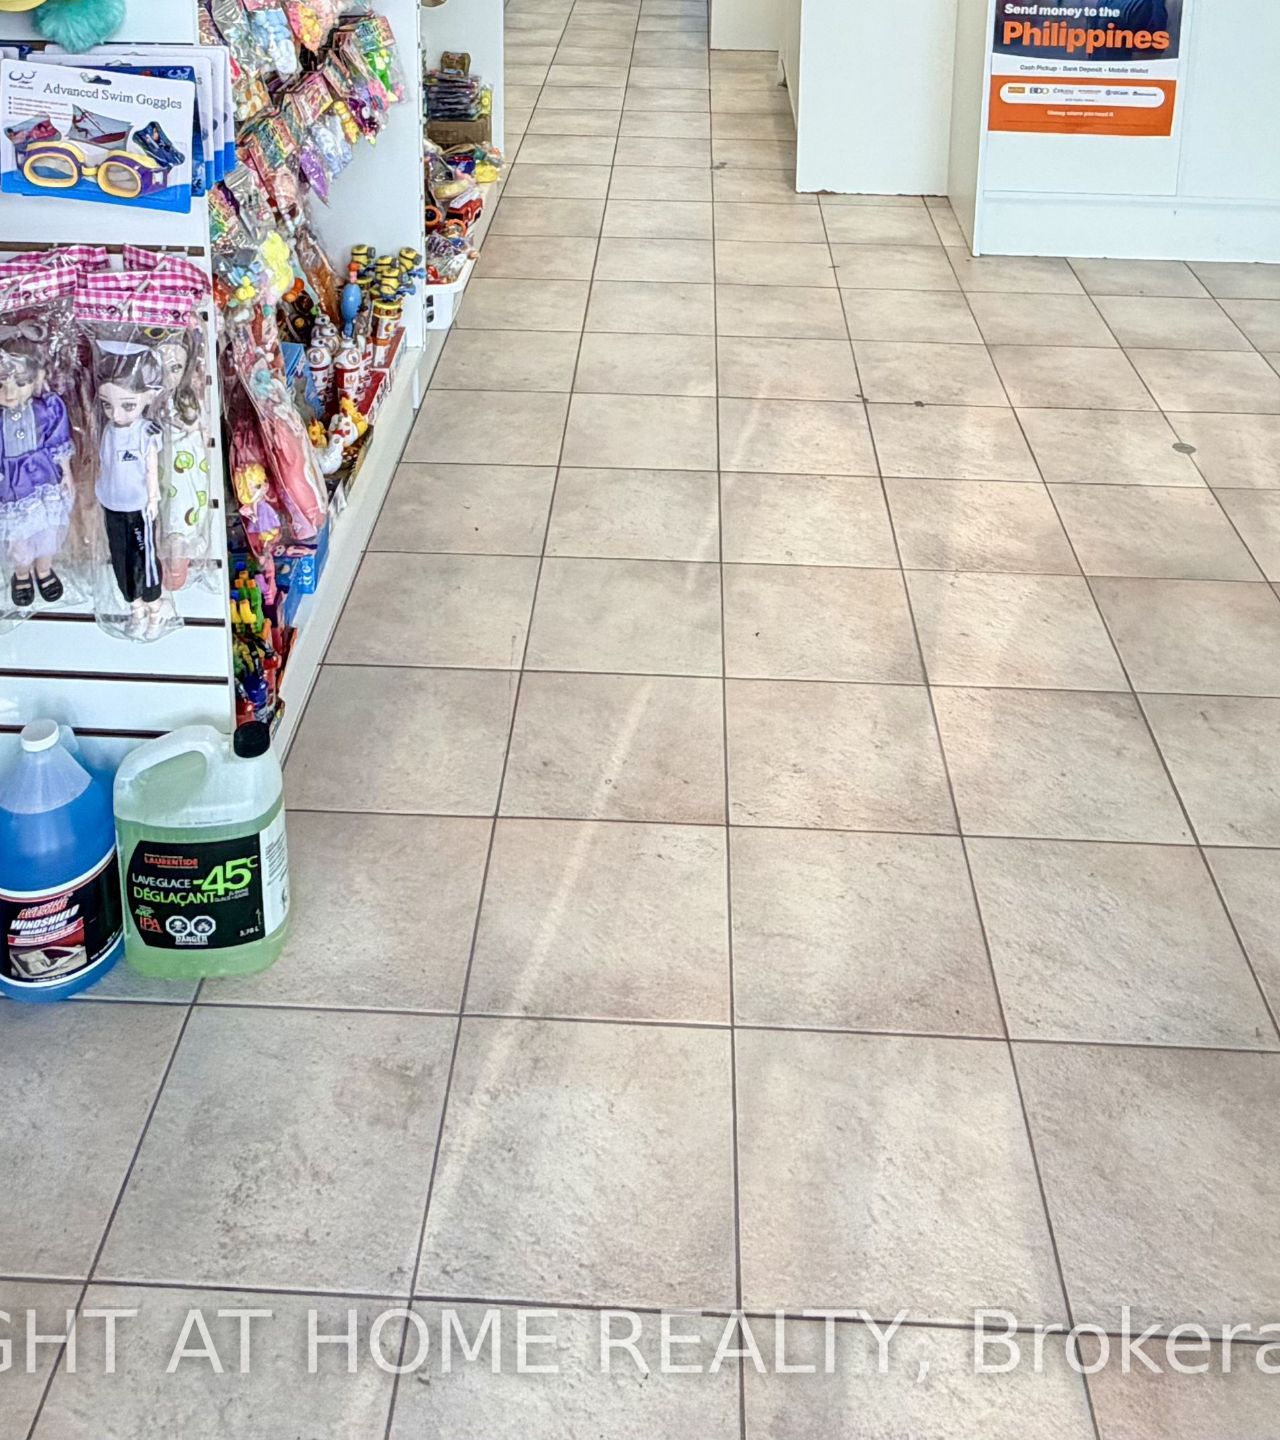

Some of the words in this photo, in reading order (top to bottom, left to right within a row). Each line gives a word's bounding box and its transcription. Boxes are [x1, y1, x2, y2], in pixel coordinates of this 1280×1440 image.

[1004, 3, 1038, 16] Send
[1039, 6, 1082, 19] money
[1084, 6, 1097, 16] to
[1098, 7, 1121, 18] the
[1003, 21, 1170, 55] Philippines
[43, 82, 99, 99] Advanced
[100, 88, 134, 103] Swim
[136, 93, 183, 110] Goggles
[133, 886, 217, 907] DÉGLAÇANT
[10, 904, 80, 931] WINDSHIELD
[139, 916, 160, 933] IPA
